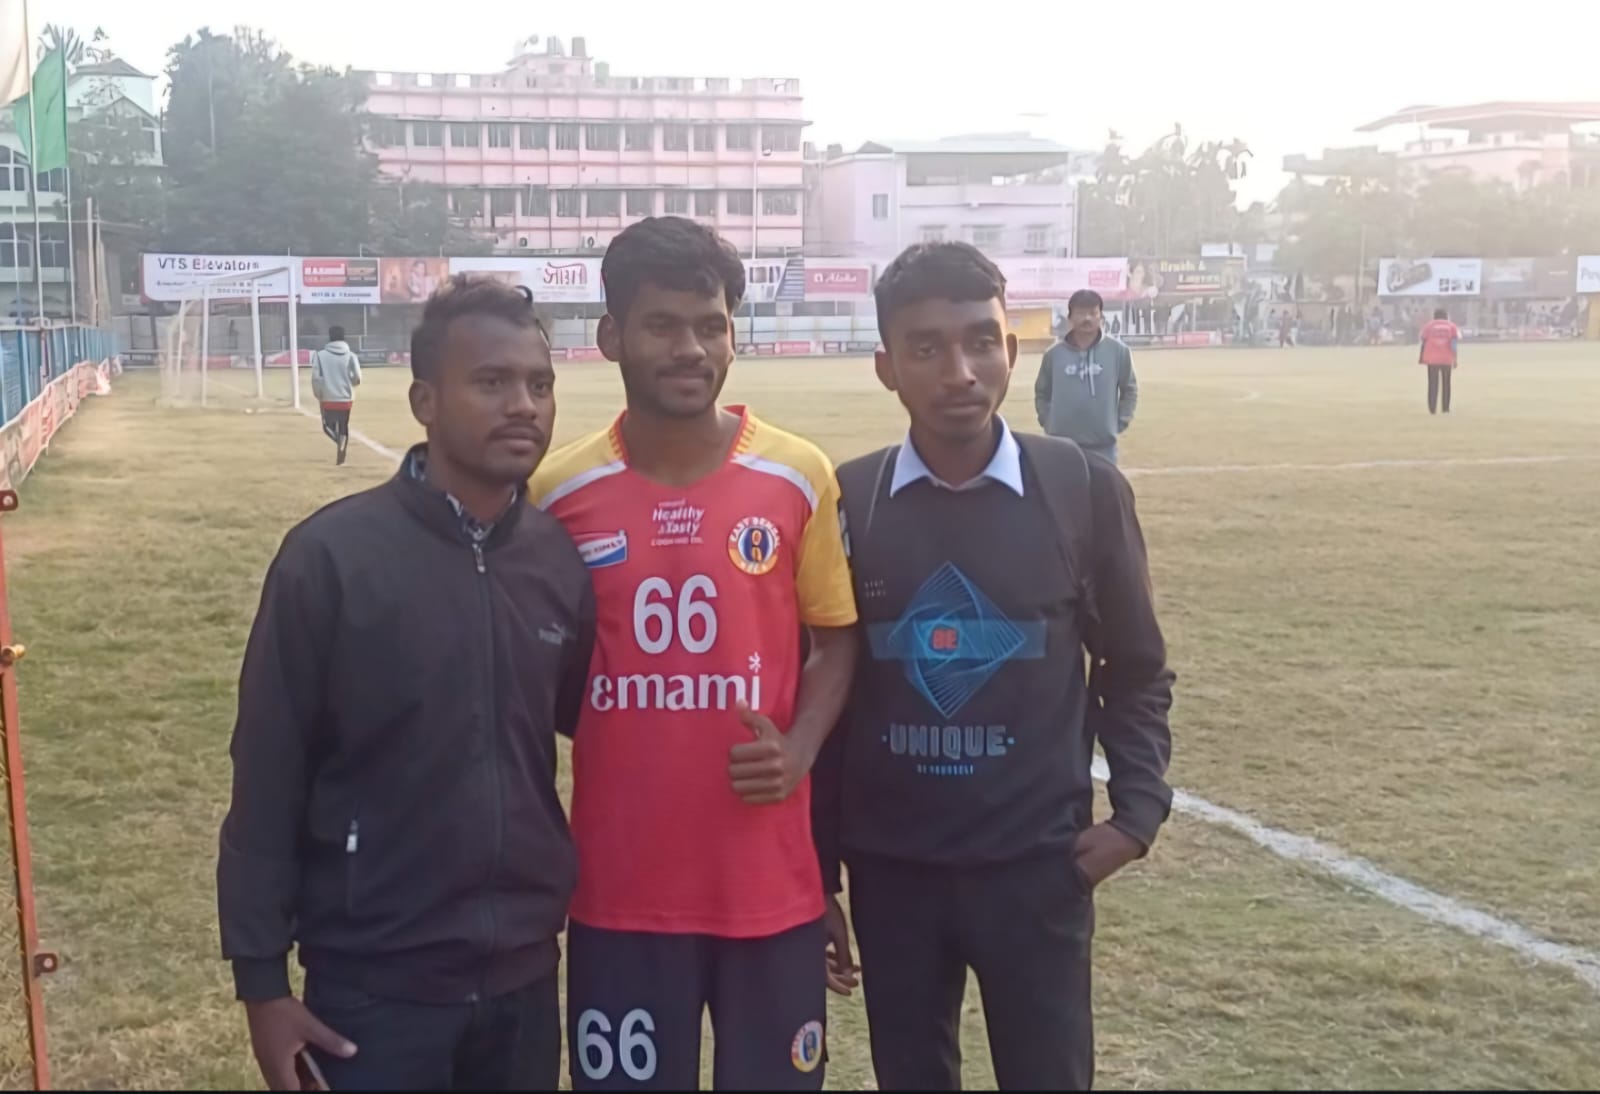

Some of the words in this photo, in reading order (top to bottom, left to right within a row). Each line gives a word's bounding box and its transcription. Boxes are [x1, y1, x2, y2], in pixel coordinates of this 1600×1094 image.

[158, 257, 188, 270] VTS
[652, 505, 705, 522] Healthy
[665, 520, 701, 537] Tasty
[633, 573, 718, 655] 66
[590, 652, 762, 712] emami
[889, 723, 1008, 760] UNIQUE
[576, 1007, 658, 1081] 66
